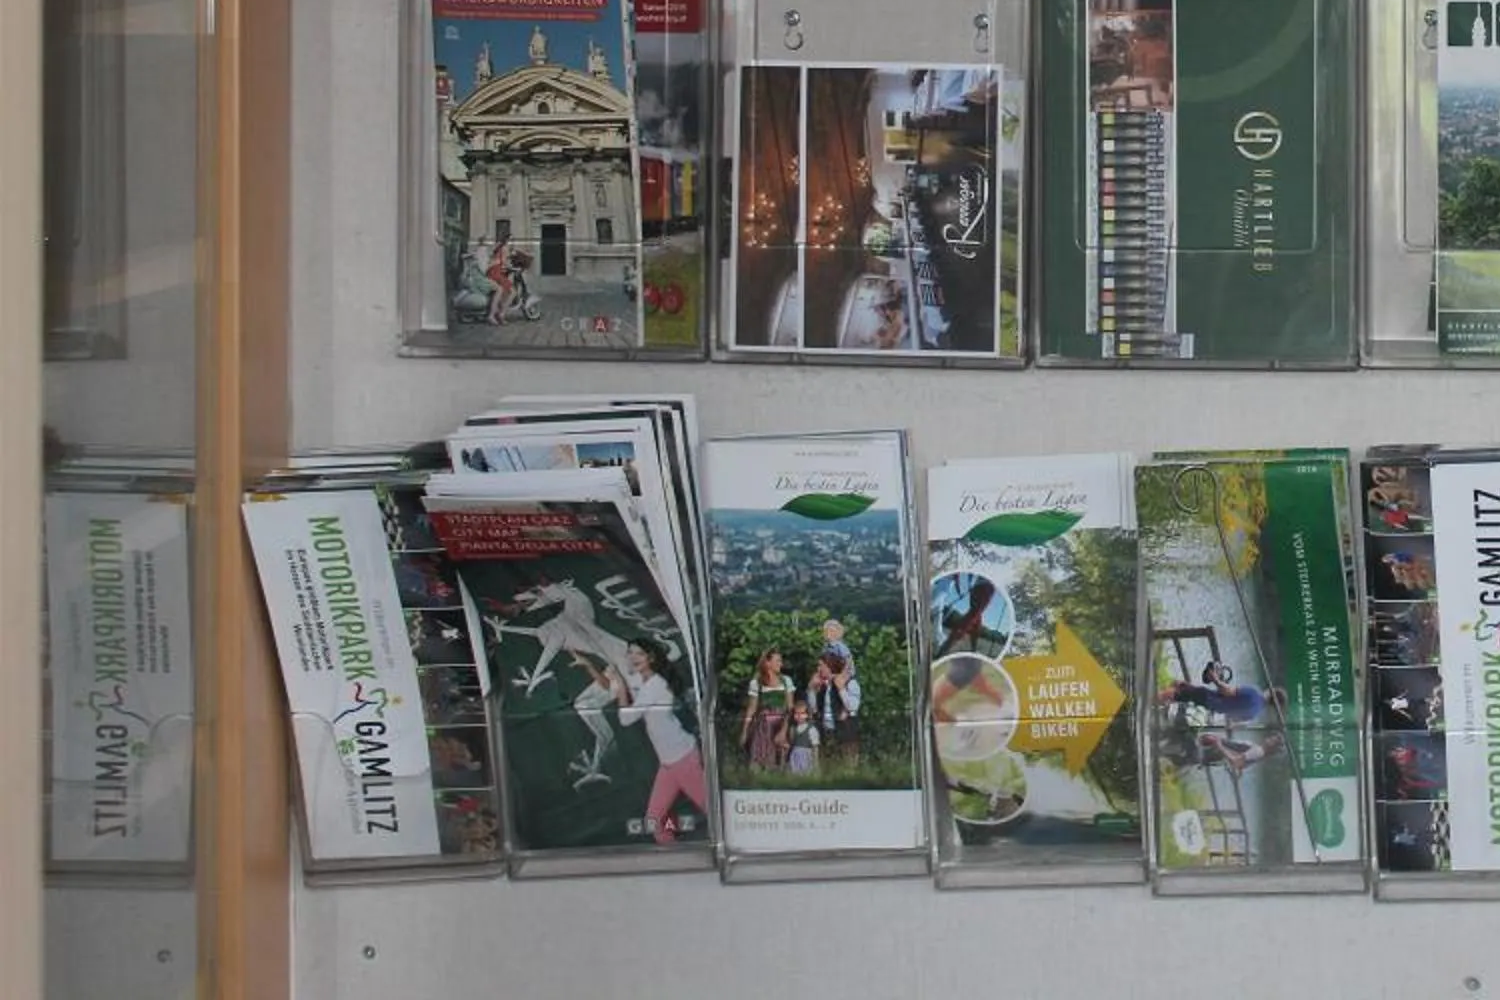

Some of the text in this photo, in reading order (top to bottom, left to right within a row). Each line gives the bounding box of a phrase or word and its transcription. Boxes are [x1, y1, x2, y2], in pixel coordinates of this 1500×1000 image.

[1253, 168, 1274, 272] HARTLIEB
[959, 490, 990, 513] Die
[1042, 490, 1088, 510] Lagen
[308, 516, 377, 681] MOTORIKPARK
[1028, 680, 1090, 700] LAUFEN
[1322, 626, 1345, 767] MURRADWEG
[1029, 698, 1097, 718] WALKEN
[1031, 722, 1079, 739] BIKEN
[355, 721, 399, 835] GAMLITZ
[734, 799, 849, 815] Gastro-Guide
